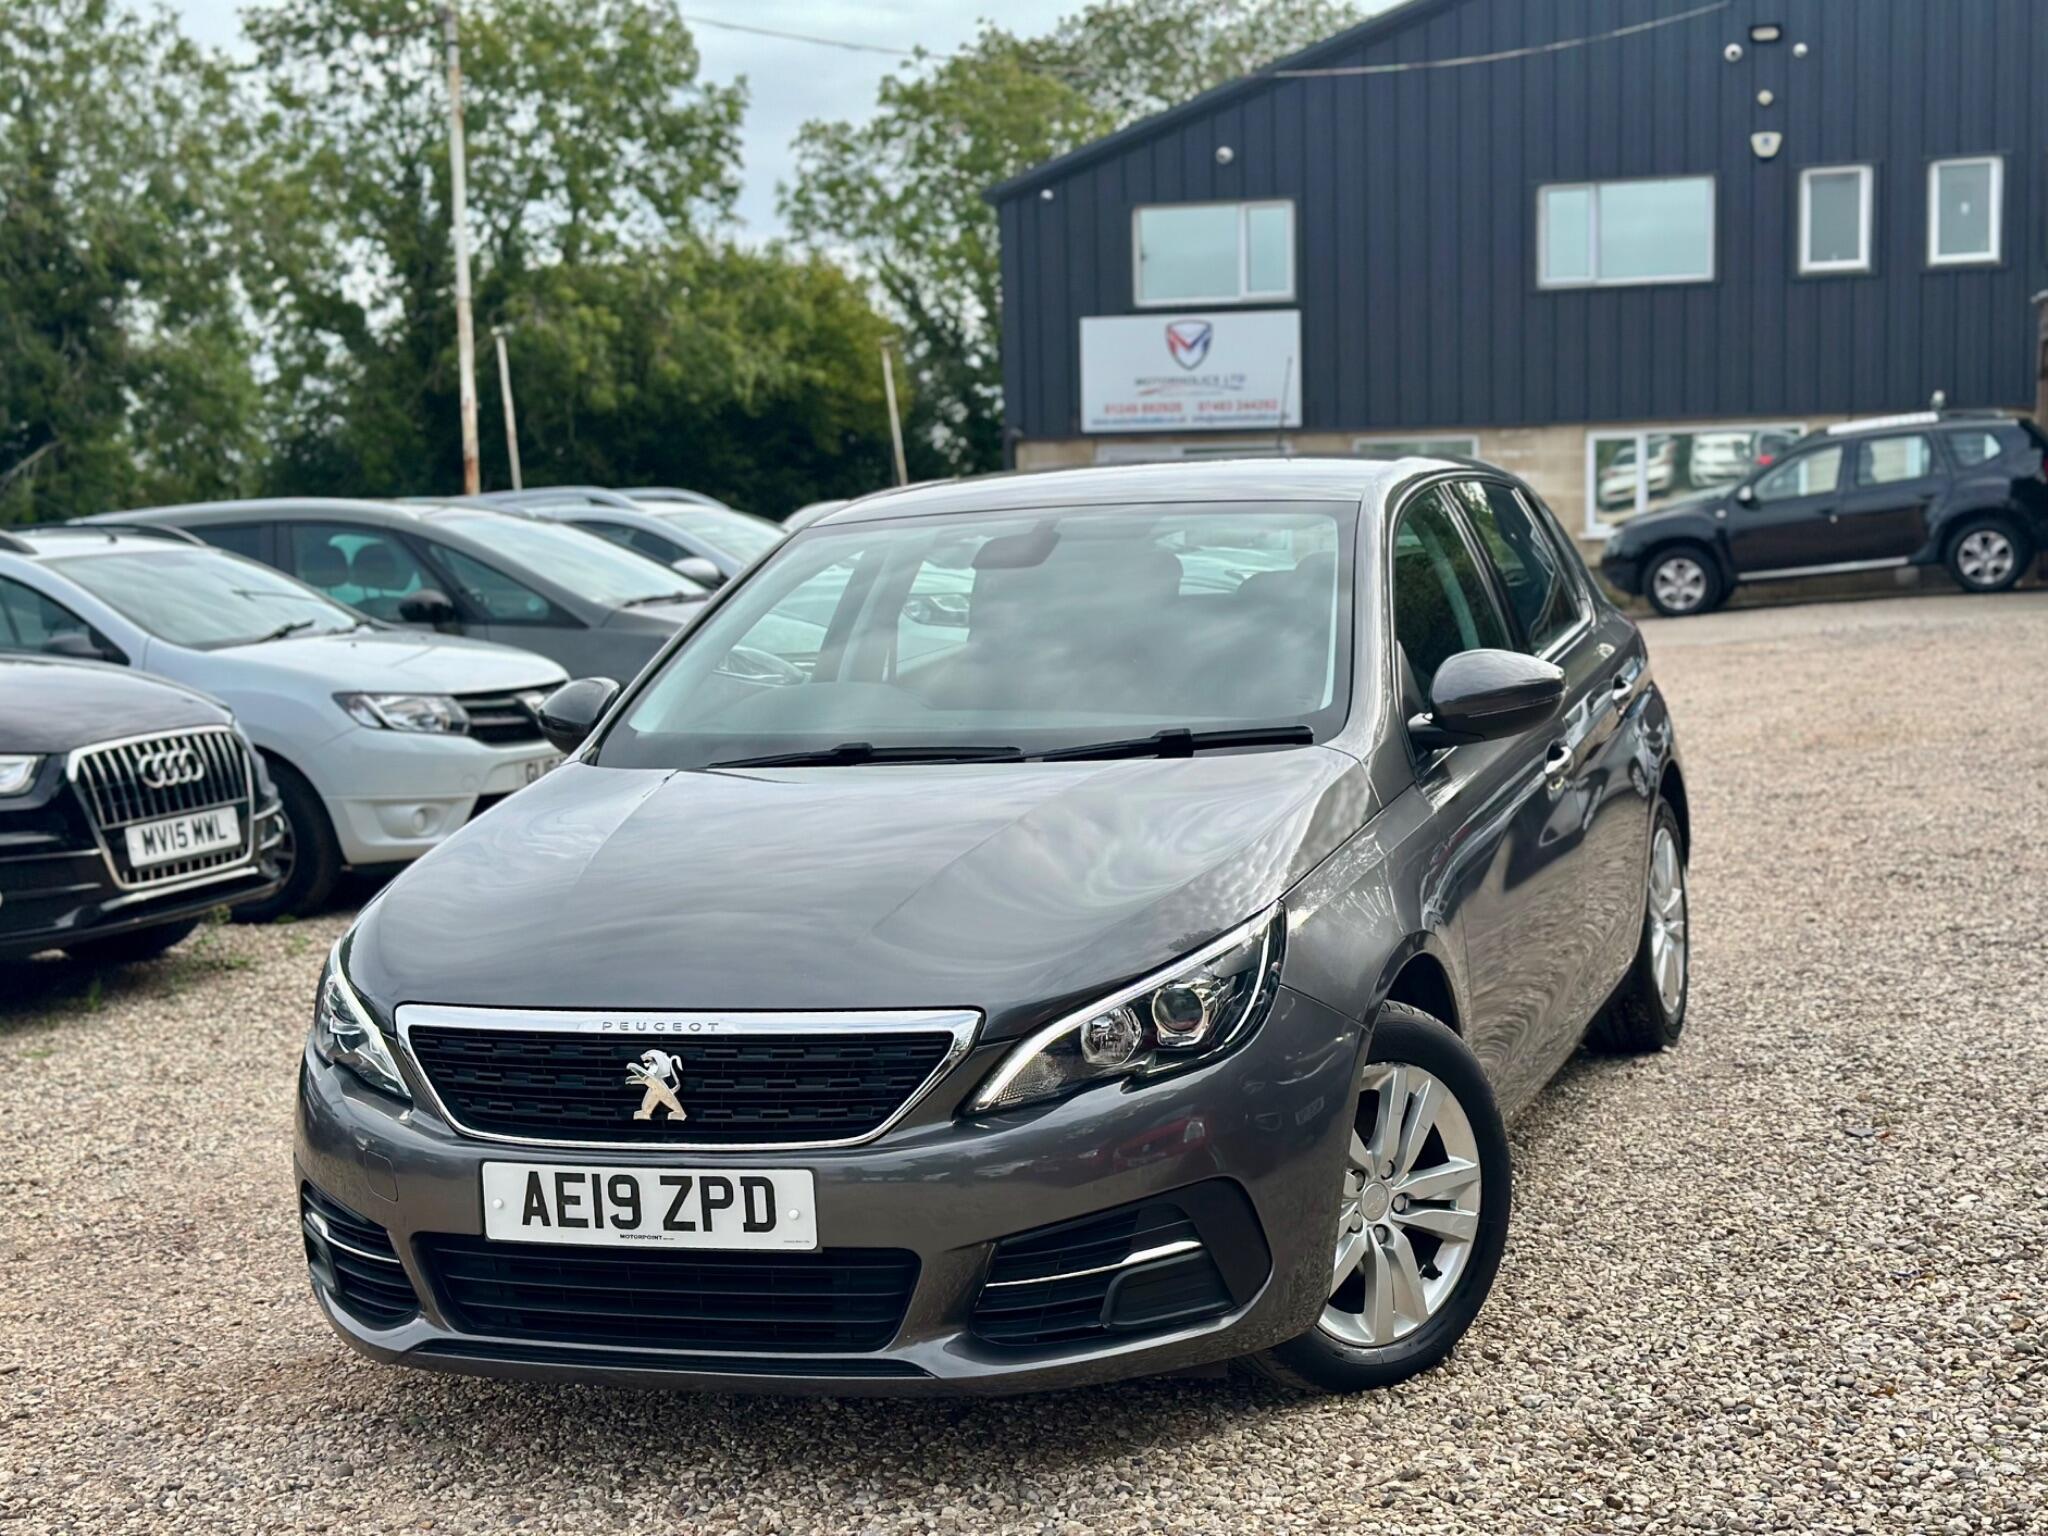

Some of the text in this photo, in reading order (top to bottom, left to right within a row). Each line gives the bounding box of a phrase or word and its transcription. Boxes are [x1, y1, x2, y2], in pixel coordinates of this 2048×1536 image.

[141, 814, 228, 857] MV15 MWL
[602, 1021, 719, 1032] PEUGEOT
[522, 1170, 777, 1234] AE19 ZPD
[619, 1233, 663, 1241] MOTORPOINT
